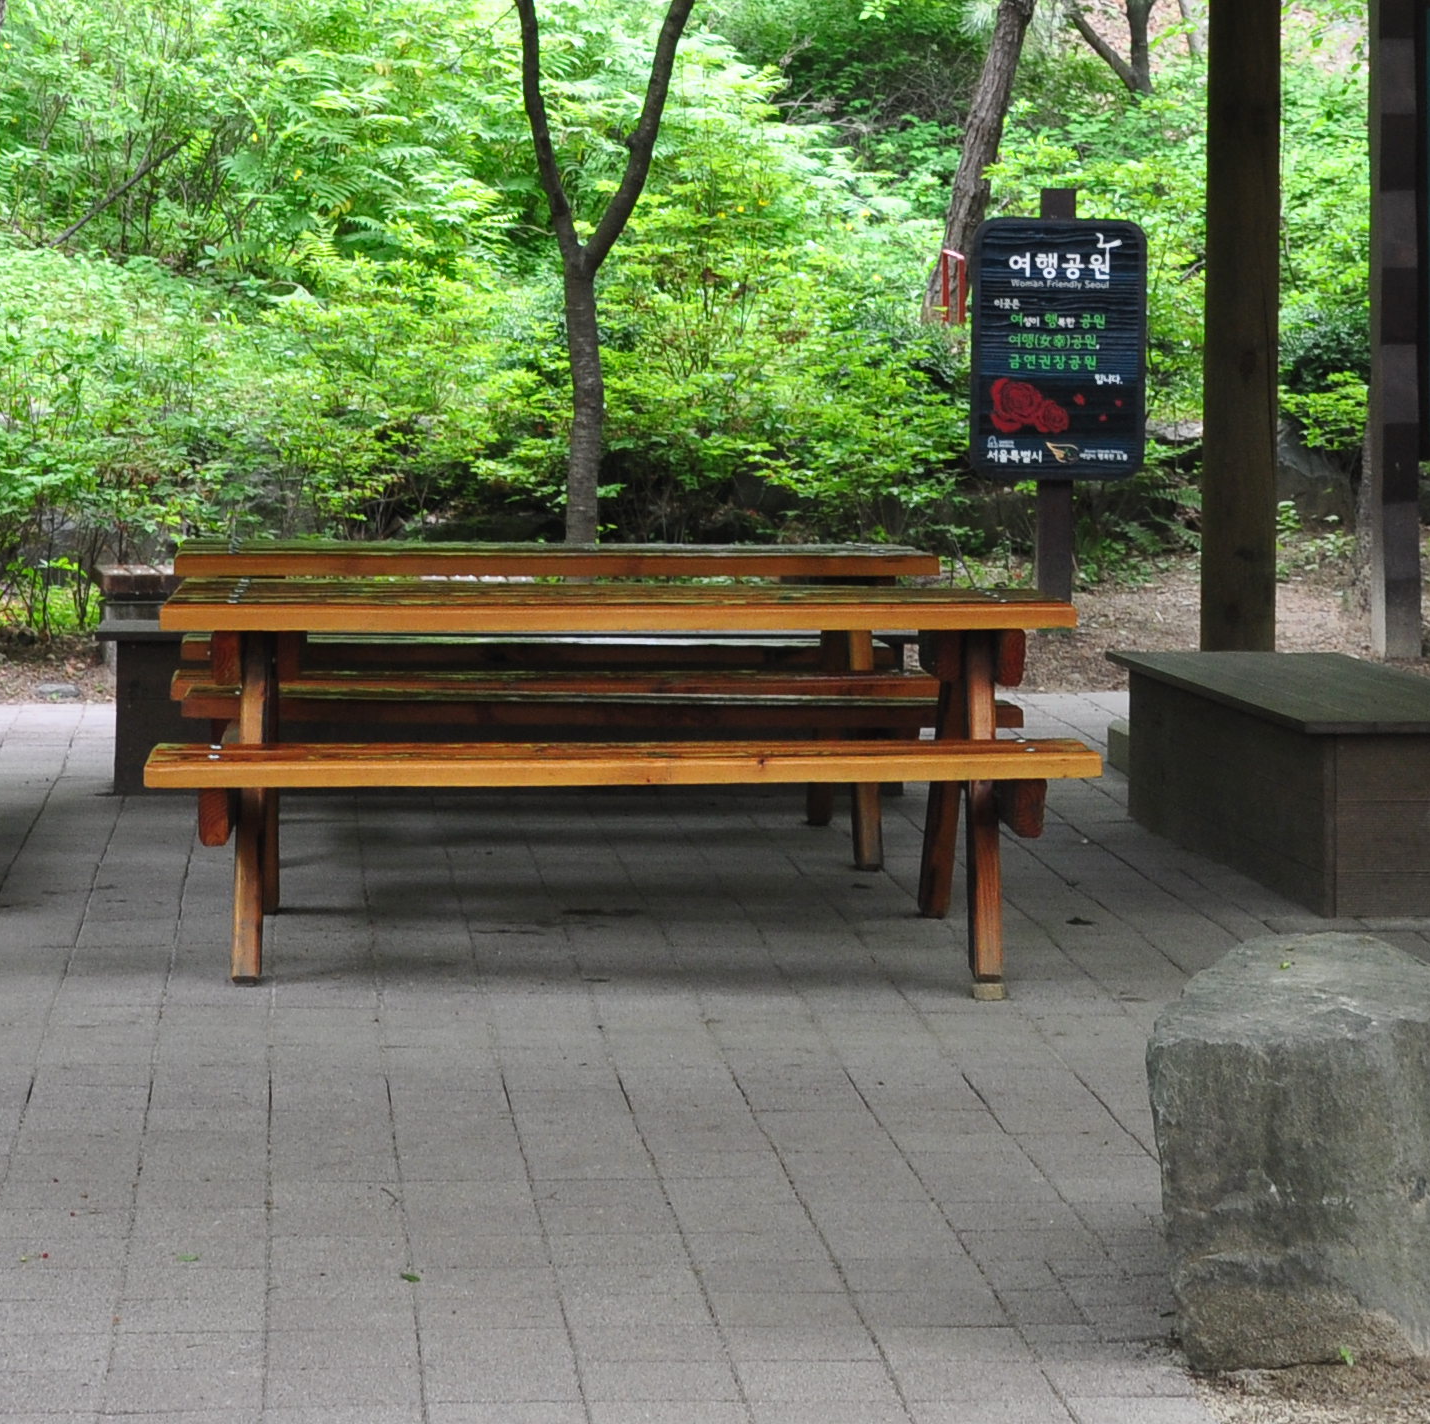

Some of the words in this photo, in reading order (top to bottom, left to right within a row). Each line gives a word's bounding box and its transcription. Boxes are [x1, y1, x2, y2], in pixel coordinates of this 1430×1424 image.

[1009, 247, 1112, 280] 여행공원
[1011, 279, 1044, 288] Woman
[1046, 279, 1082, 290] Friendly
[1085, 280, 1110, 289] Seoul
[994, 298, 1021, 309] 이곳은
[1010, 313, 1040, 327] 여성이
[1044, 312, 1075, 328] 행복한
[1080, 313, 1106, 329] 공원
[986, 449, 1043, 464] 서울특별시
